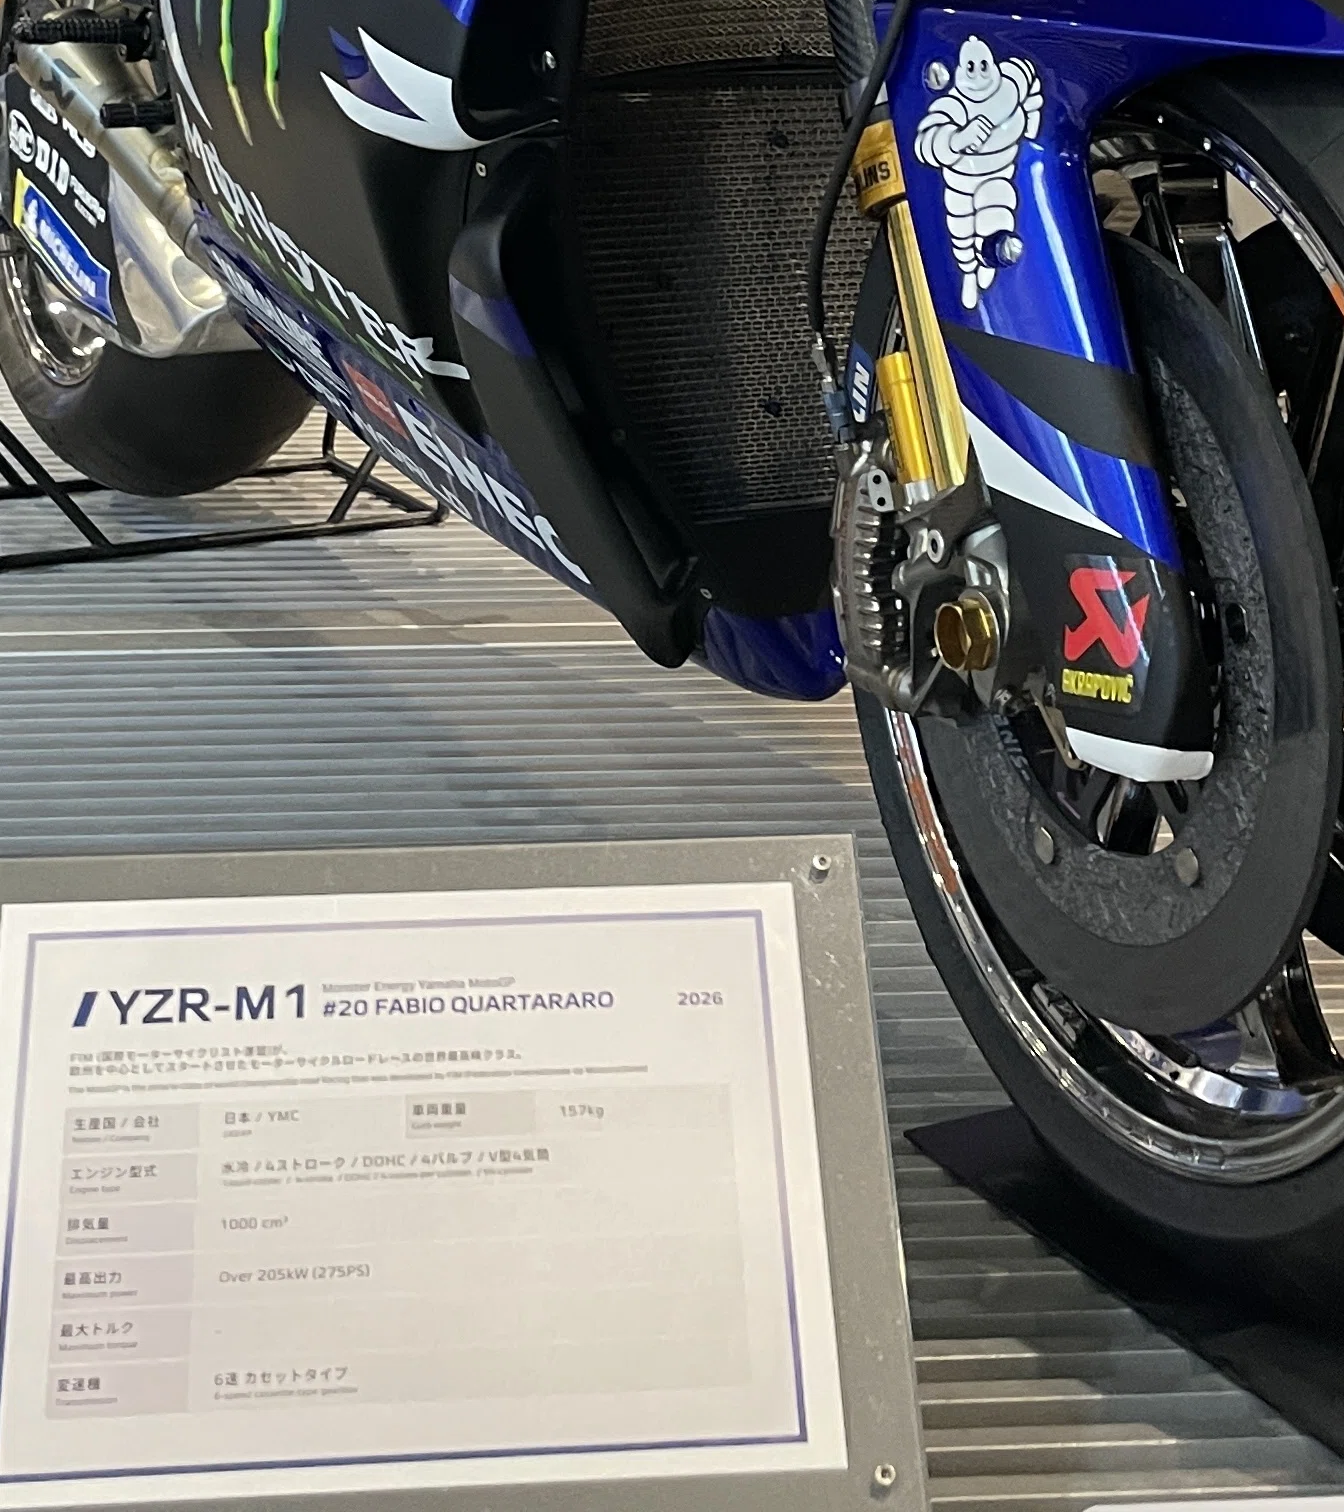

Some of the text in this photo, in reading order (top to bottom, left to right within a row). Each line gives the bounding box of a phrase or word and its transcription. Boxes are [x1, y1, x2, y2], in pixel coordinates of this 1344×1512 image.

[109, 983, 306, 1026] YZR-M1
[322, 990, 615, 1018] #20 FABIO QUARTARARO
[677, 991, 724, 1007] 2026
[267, 1109, 300, 1123] YMC
[560, 1104, 604, 1119] 157kg
[362, 1154, 406, 1168] DOHC
[221, 1216, 258, 1231] 1000
[218, 1263, 372, 1284] Over 205kW (275PS)
[245, 1366, 349, 1385] カセットタイプ
